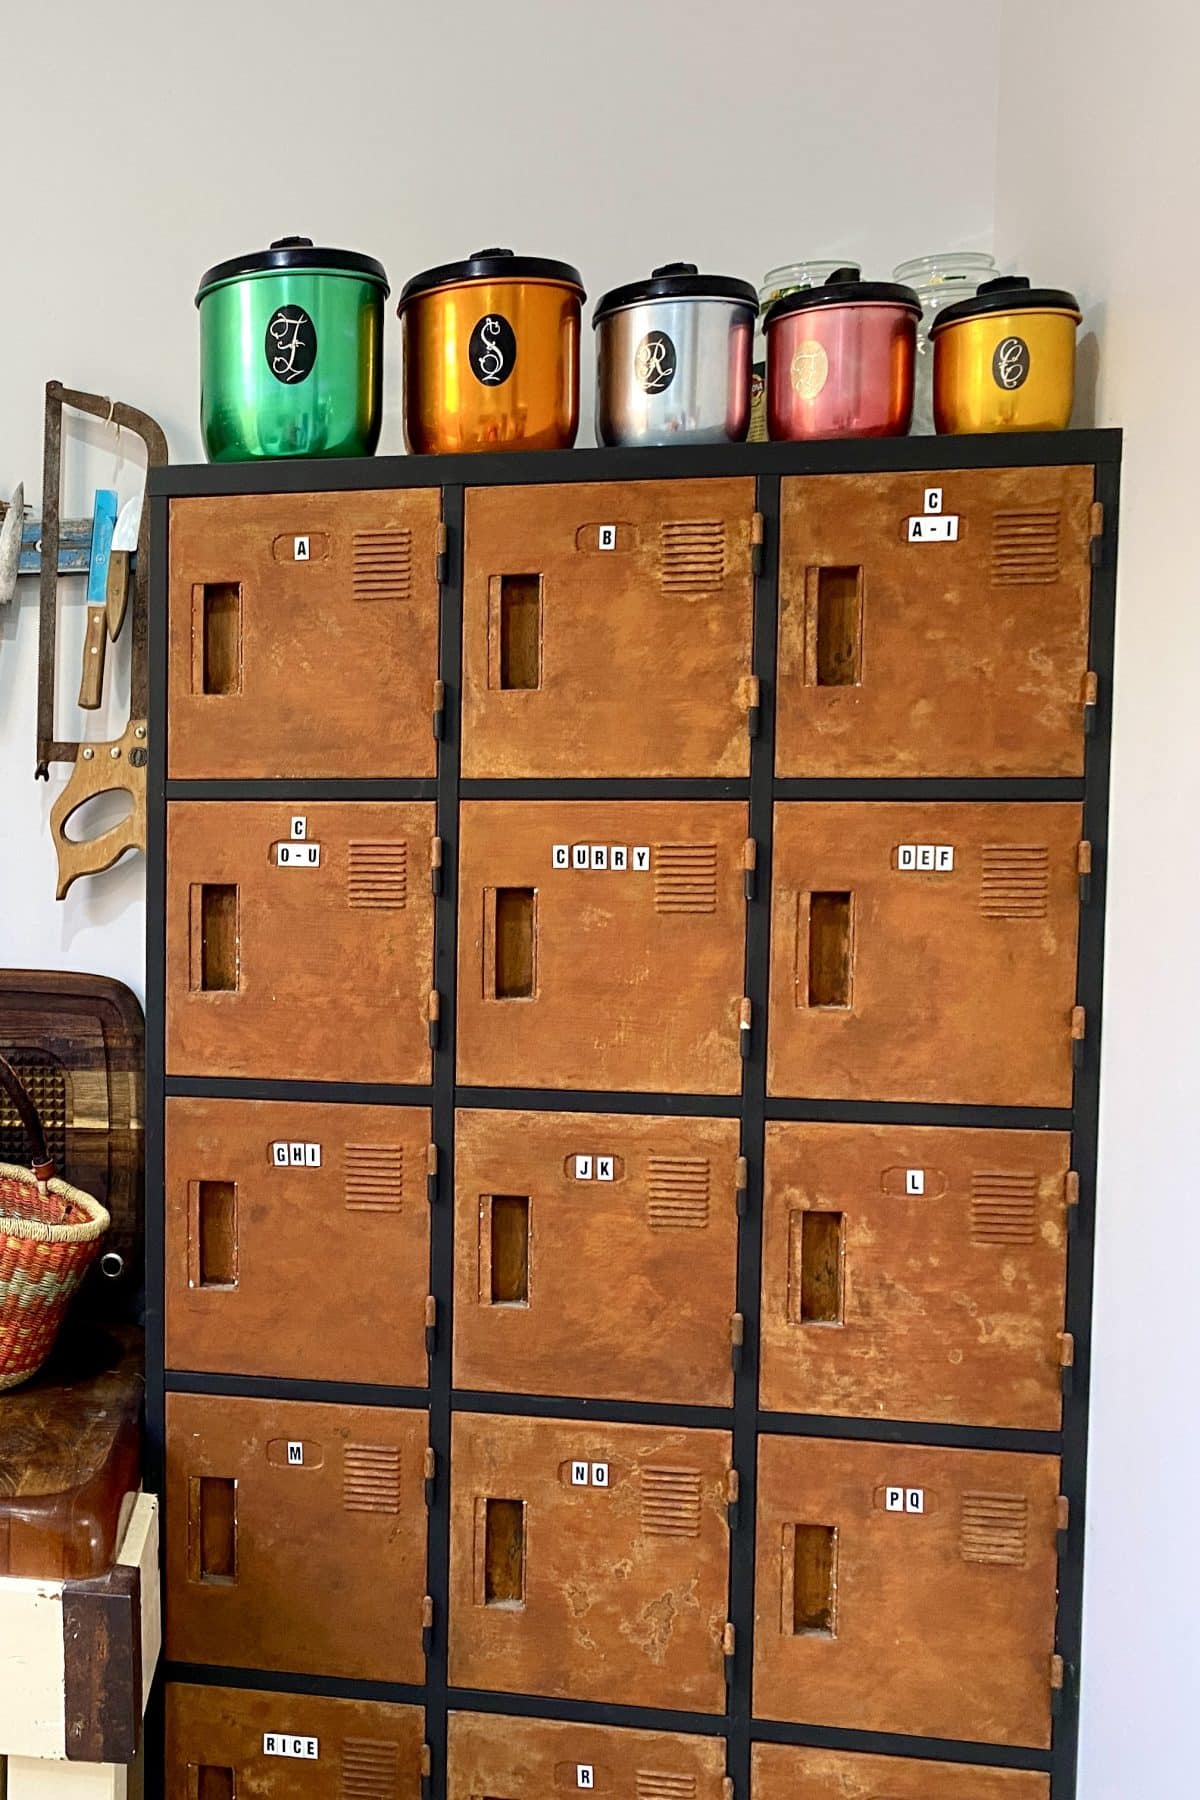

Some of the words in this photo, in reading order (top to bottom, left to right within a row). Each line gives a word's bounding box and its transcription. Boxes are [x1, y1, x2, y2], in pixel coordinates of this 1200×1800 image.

[928, 492, 939, 509] C
[294, 820, 303, 835] C
[556, 848, 646, 867] CURRY
[902, 850, 949, 866] DEF
[277, 1147, 315, 1162] GHI
[580, 1161, 610, 1176] JK
[575, 1466, 605, 1482] NO
[890, 1491, 920, 1509] PQ
[267, 1737, 315, 1755] RICE
